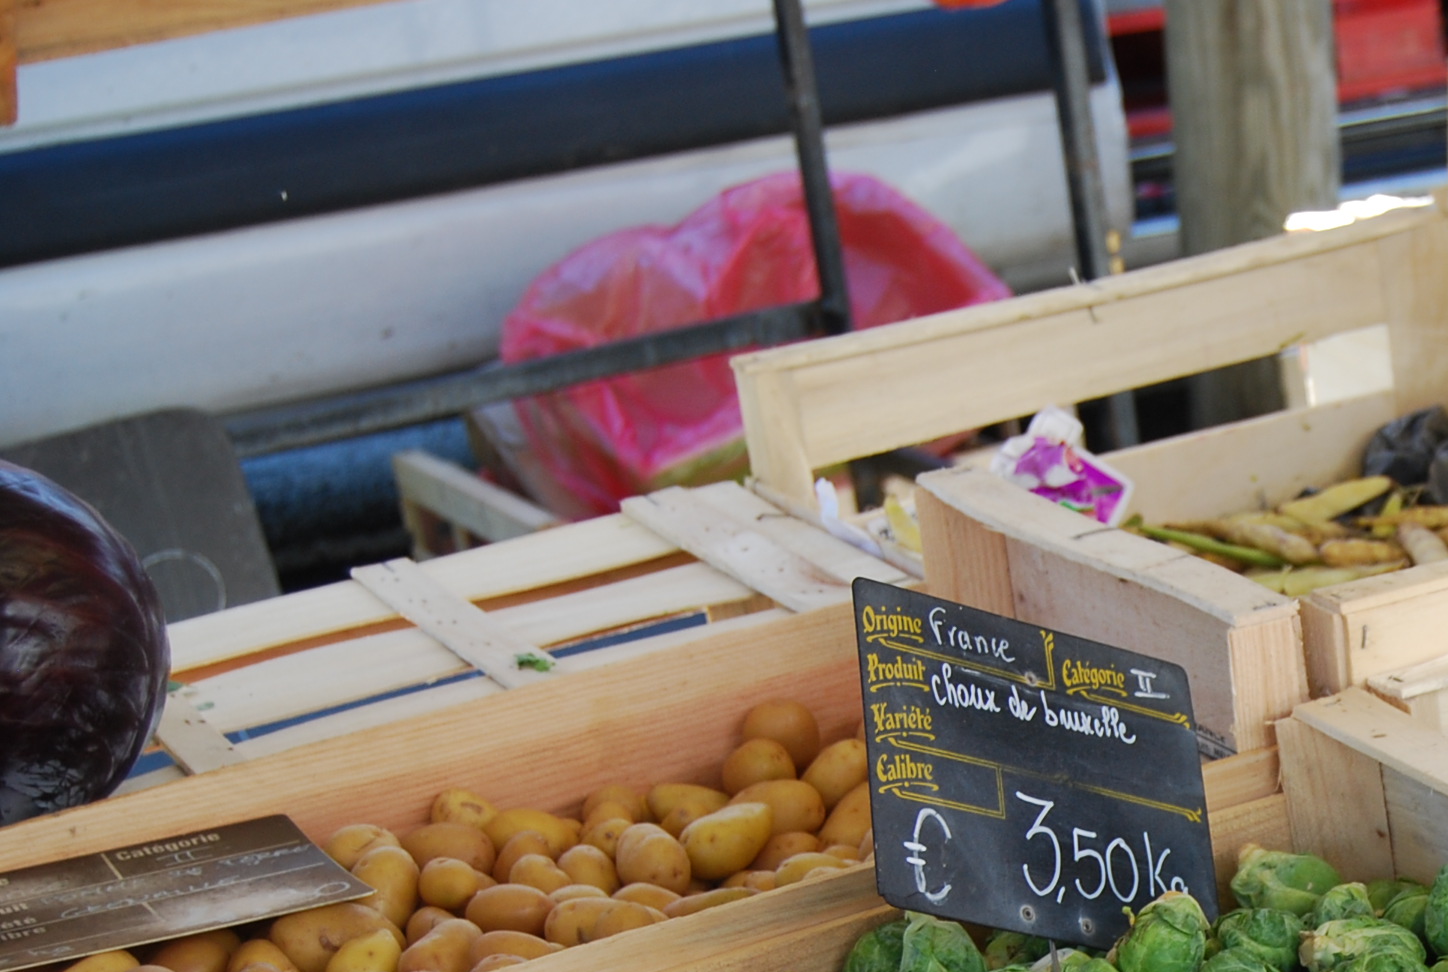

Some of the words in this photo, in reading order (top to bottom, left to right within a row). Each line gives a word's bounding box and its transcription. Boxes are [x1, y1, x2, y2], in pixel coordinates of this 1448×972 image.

[863, 605, 923, 637] Origine
[928, 606, 1016, 664] France
[867, 653, 927, 682] Produit
[1008, 684, 1037, 722] de
[1061, 658, 1126, 690] Catégorie
[871, 700, 933, 734] Variété
[876, 753, 934, 782] Calibre
[115, 832, 221, 862] Catégorie
